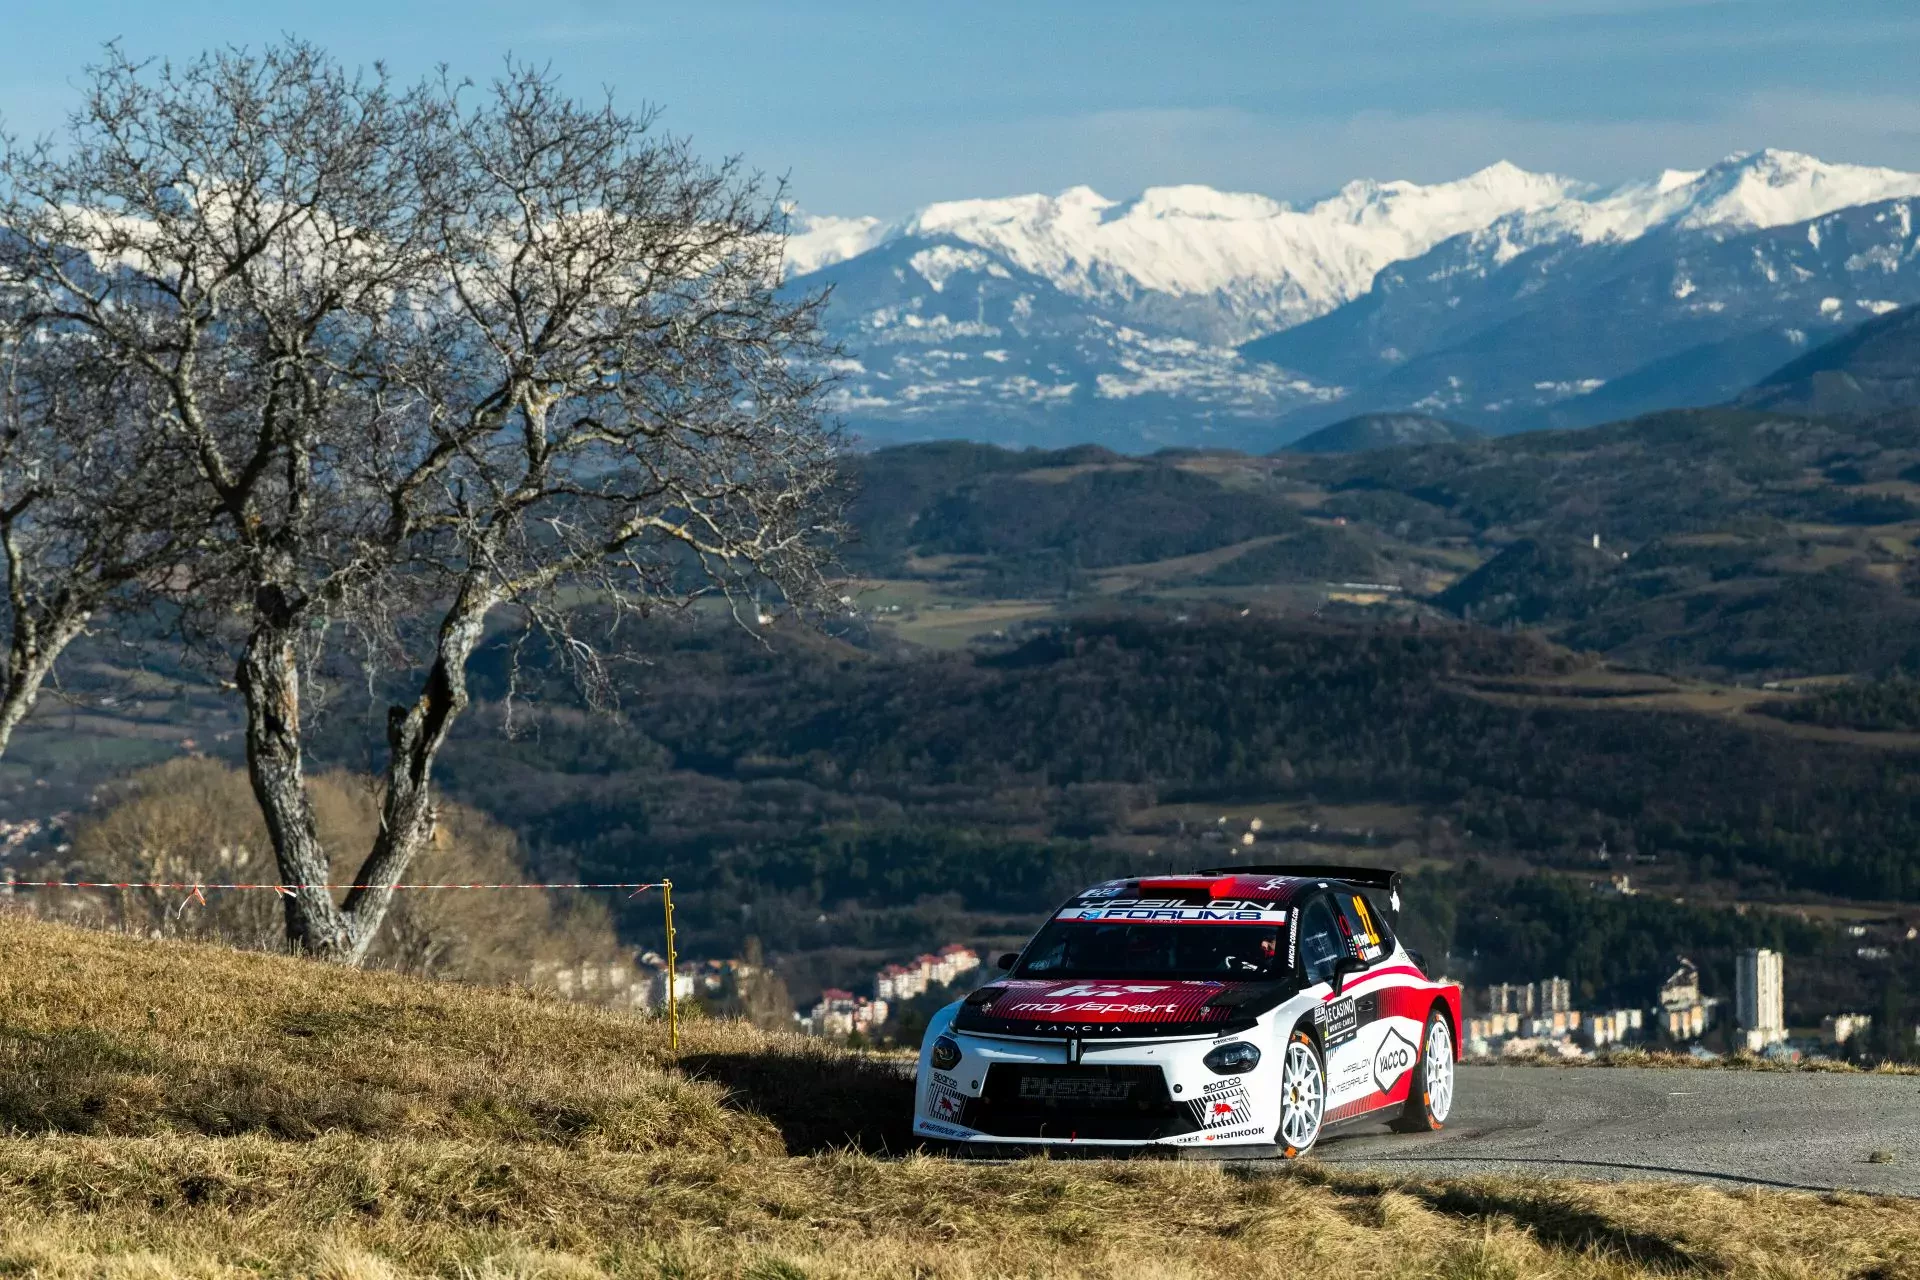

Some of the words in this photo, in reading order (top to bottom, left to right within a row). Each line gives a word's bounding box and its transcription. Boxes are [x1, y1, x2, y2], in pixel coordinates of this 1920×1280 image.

[1080, 899, 1276, 911] YPSILON
[1104, 909, 1262, 921] FORUM8
[1332, 998, 1354, 1022] CASINO
[1034, 1024, 1123, 1033] LANCIA
[1379, 1048, 1409, 1073] YACCO
[933, 1072, 957, 1088] sparco
[1202, 1077, 1242, 1093] sparco
